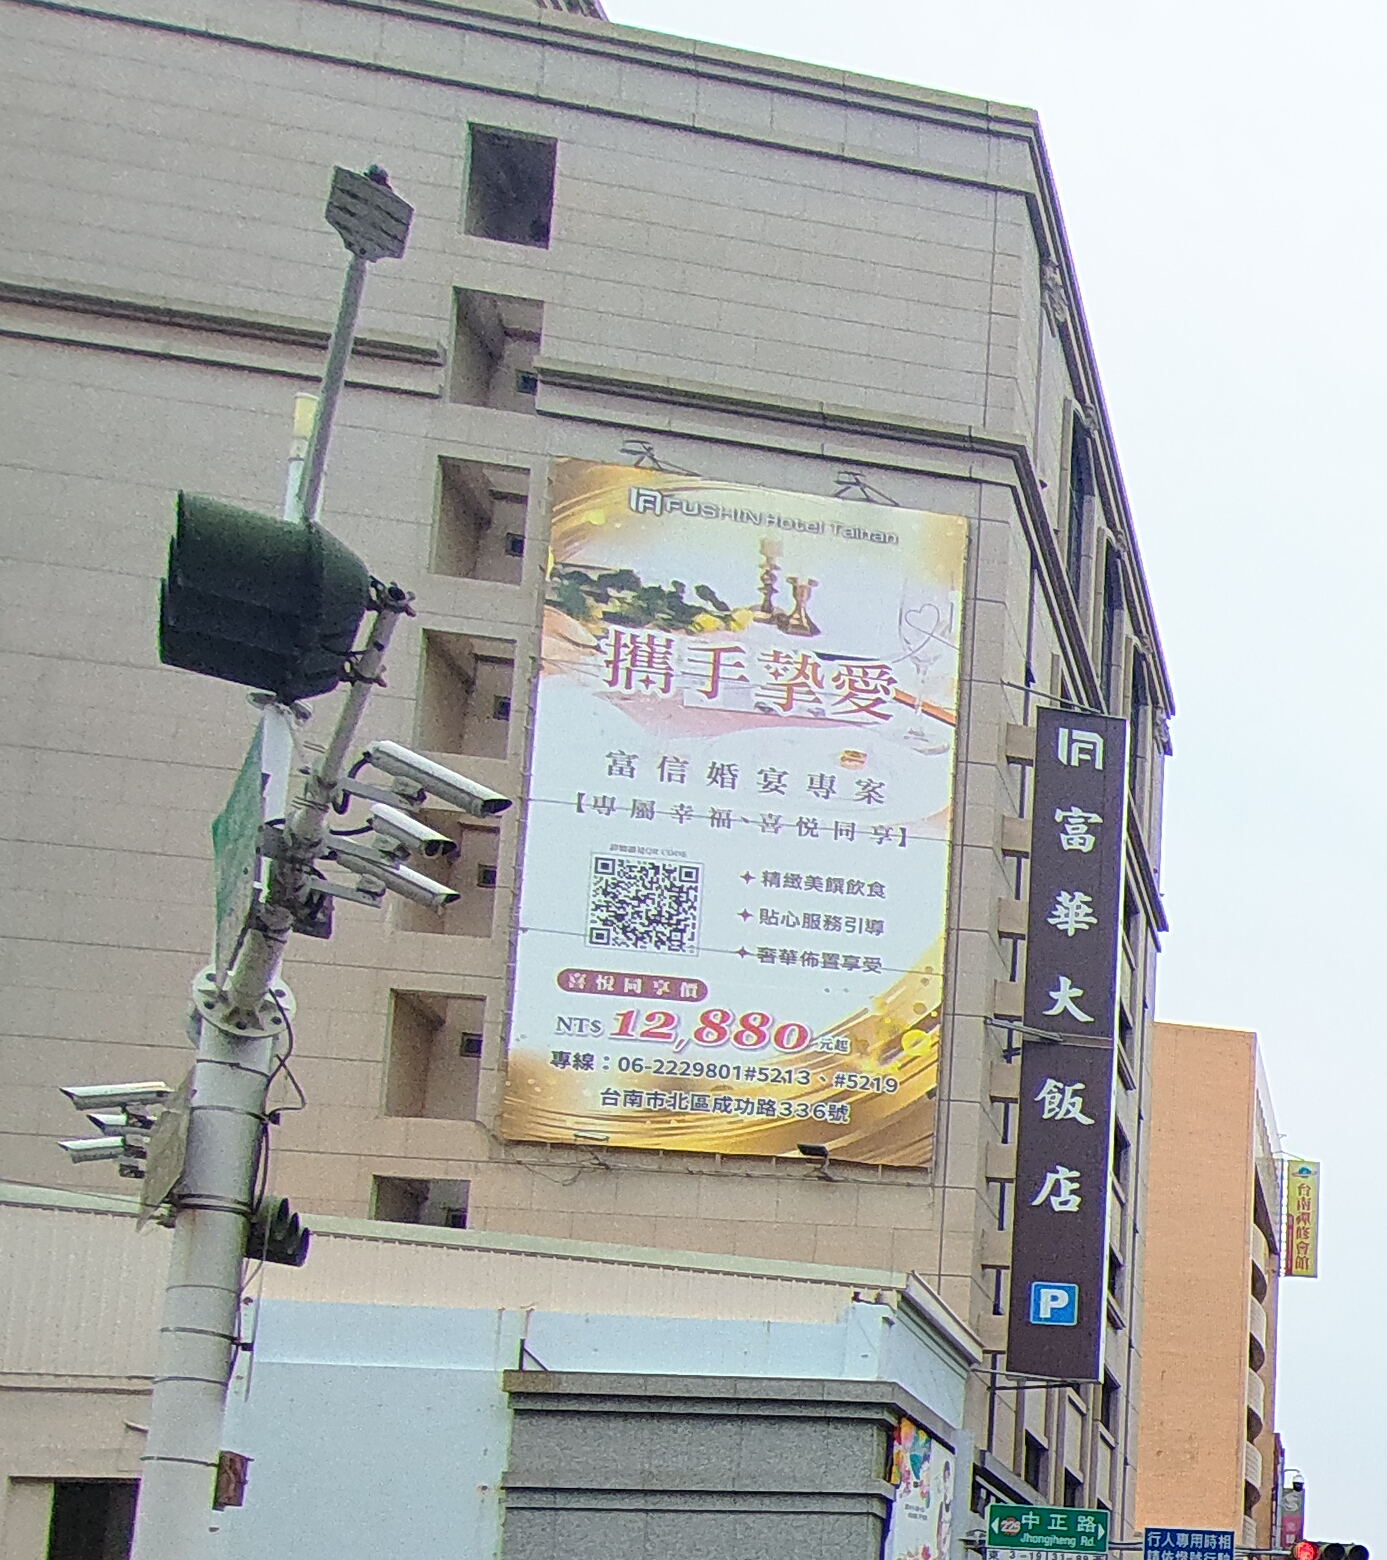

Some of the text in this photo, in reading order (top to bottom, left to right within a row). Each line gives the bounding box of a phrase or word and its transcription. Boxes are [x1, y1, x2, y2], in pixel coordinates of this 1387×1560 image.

[664, 499, 762, 526] FUSHIN
[603, 628, 898, 722] 攜手摯愛
[605, 749, 887, 806] 富信婚宴專案
[760, 869, 887, 900] 精緻美饌飲食
[758, 908, 885, 938] 貼心服務引導
[1031, 805, 1102, 1214] 富華大飯店
[609, 1008, 812, 1052] 12,880
[819, 1037, 849, 1053] 元起
[599, 1087, 852, 1123] 台南市北區成功路336號
[1021, 1510, 1097, 1534] 中正路
[1147, 1531, 1232, 1550] 行人專用時相
